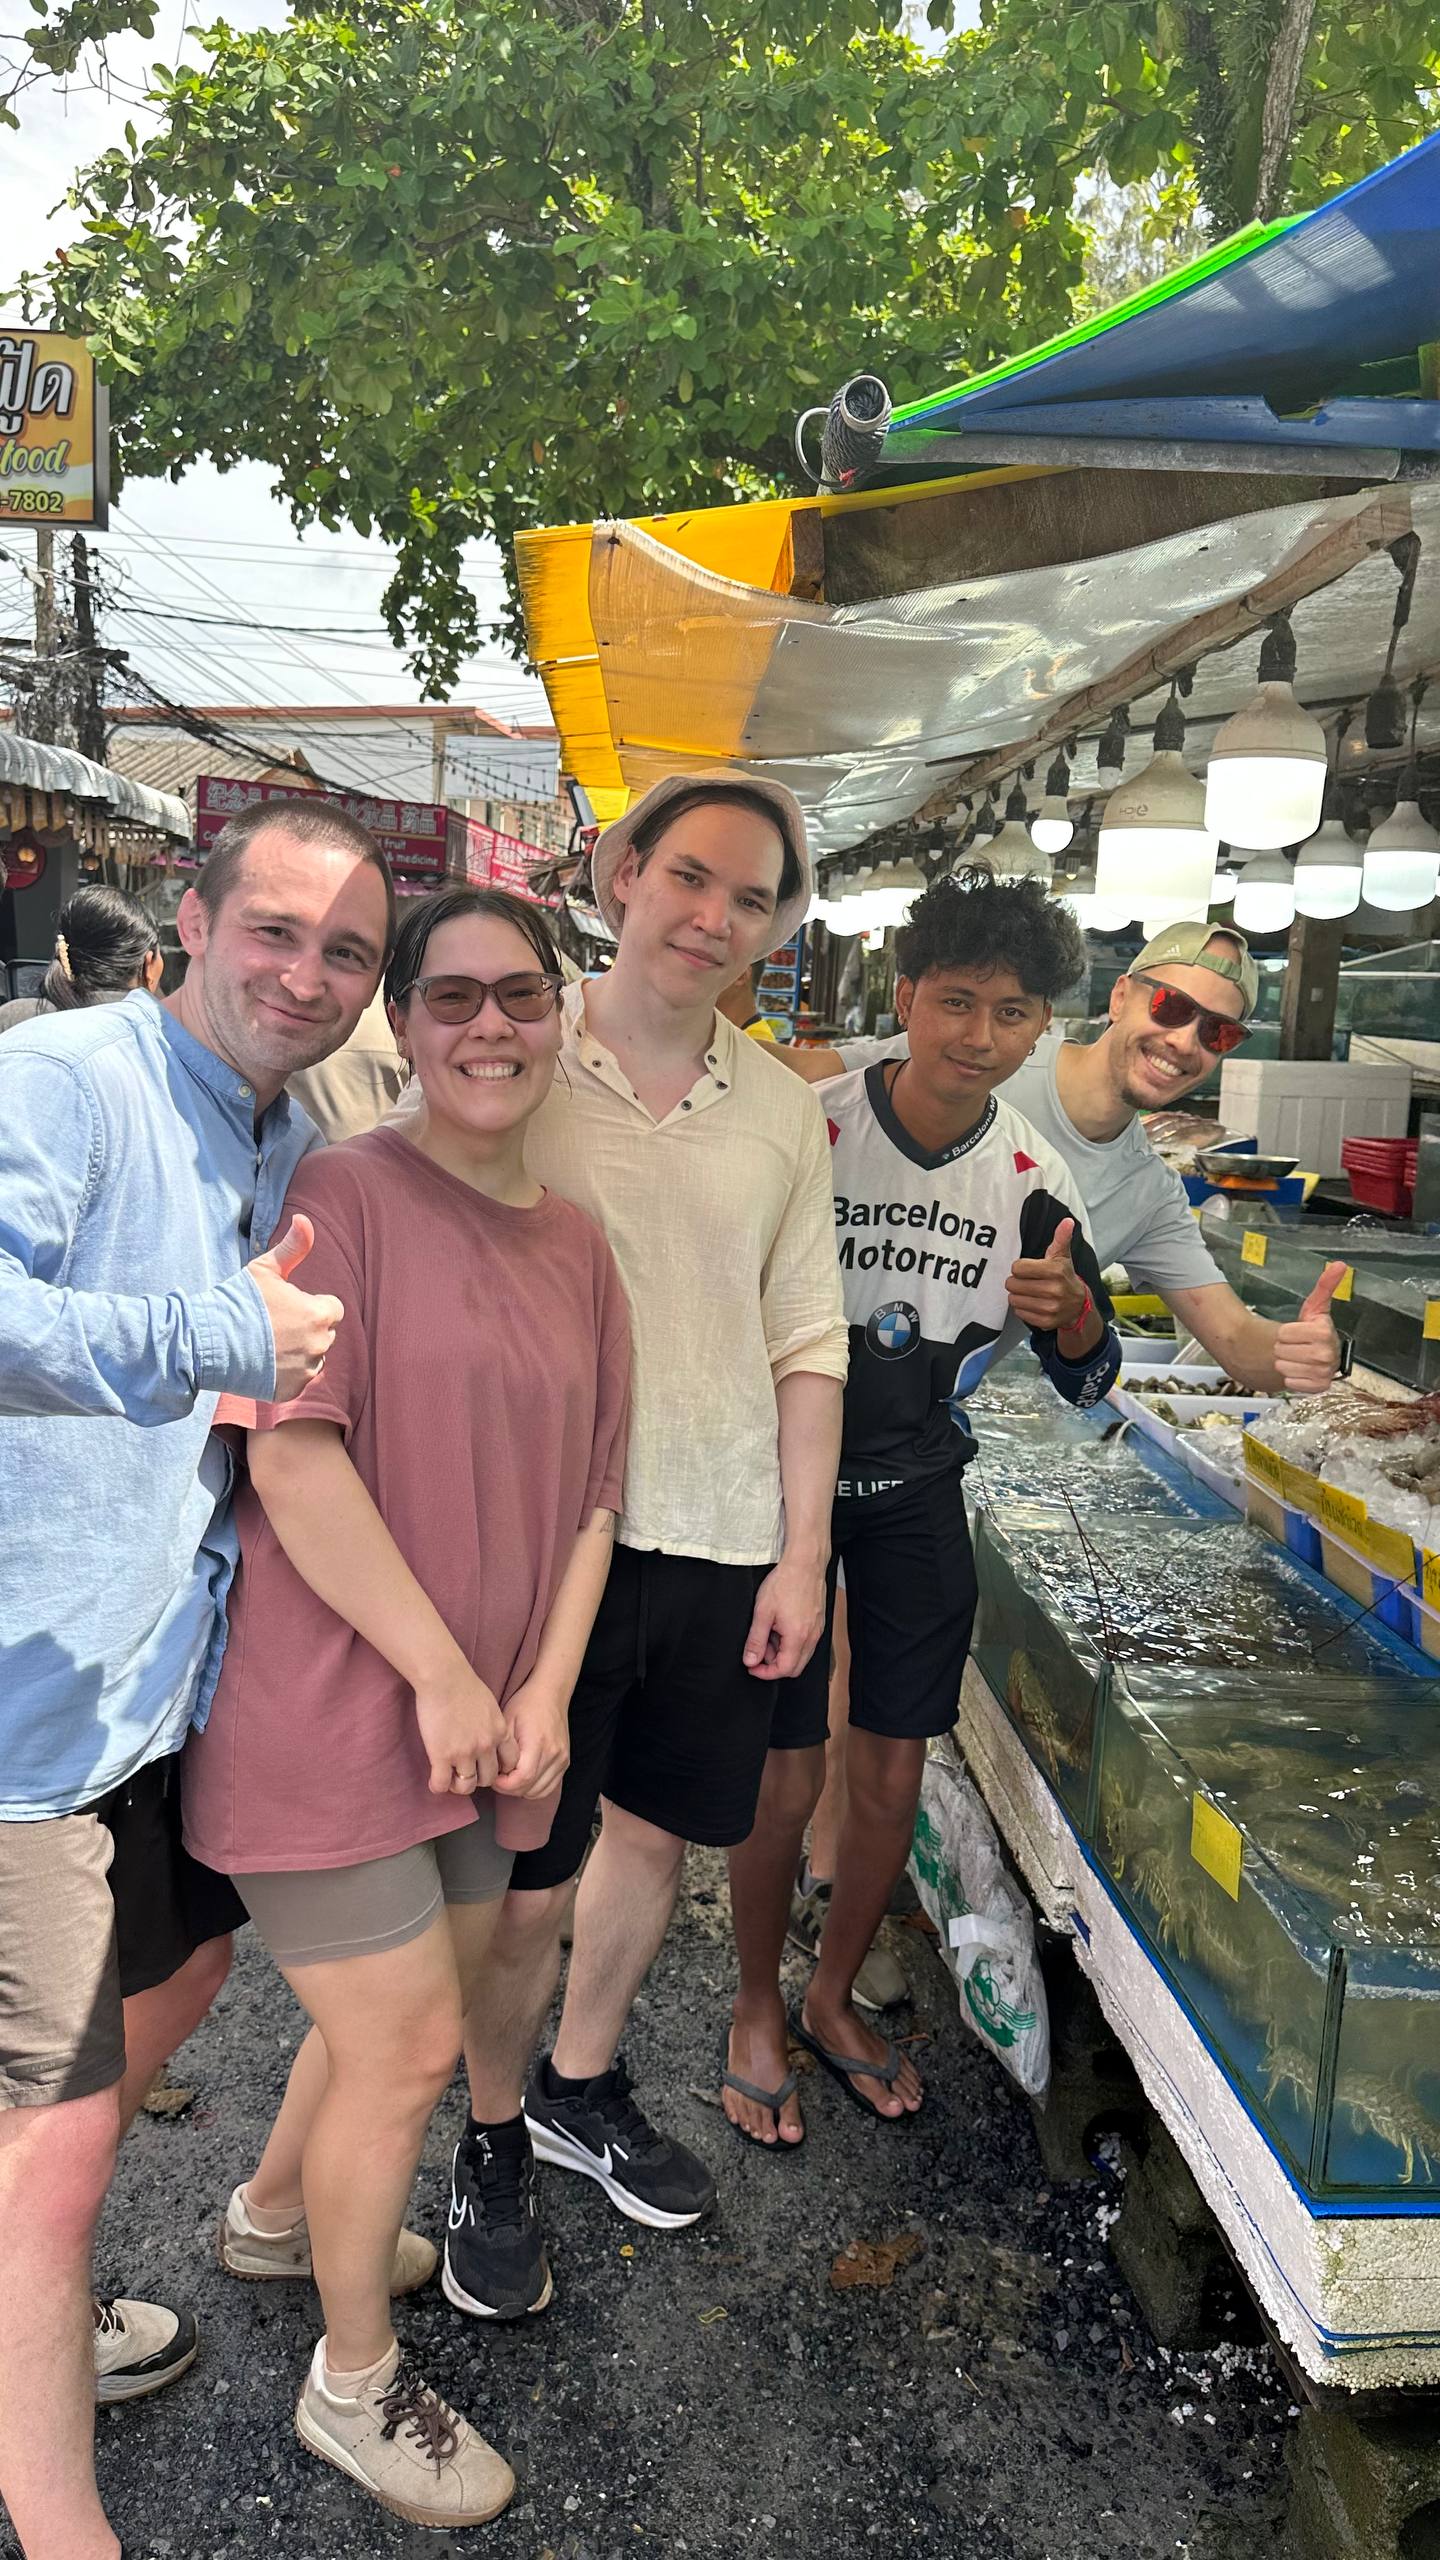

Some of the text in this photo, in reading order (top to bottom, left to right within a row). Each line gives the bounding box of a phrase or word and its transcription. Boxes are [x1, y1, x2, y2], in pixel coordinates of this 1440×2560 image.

[396, 853, 439, 867] medicine
[951, 1112, 993, 1157] Barcelona
[833, 1196, 998, 1249] Barcelona
[874, 1302, 919, 1323] BMW
